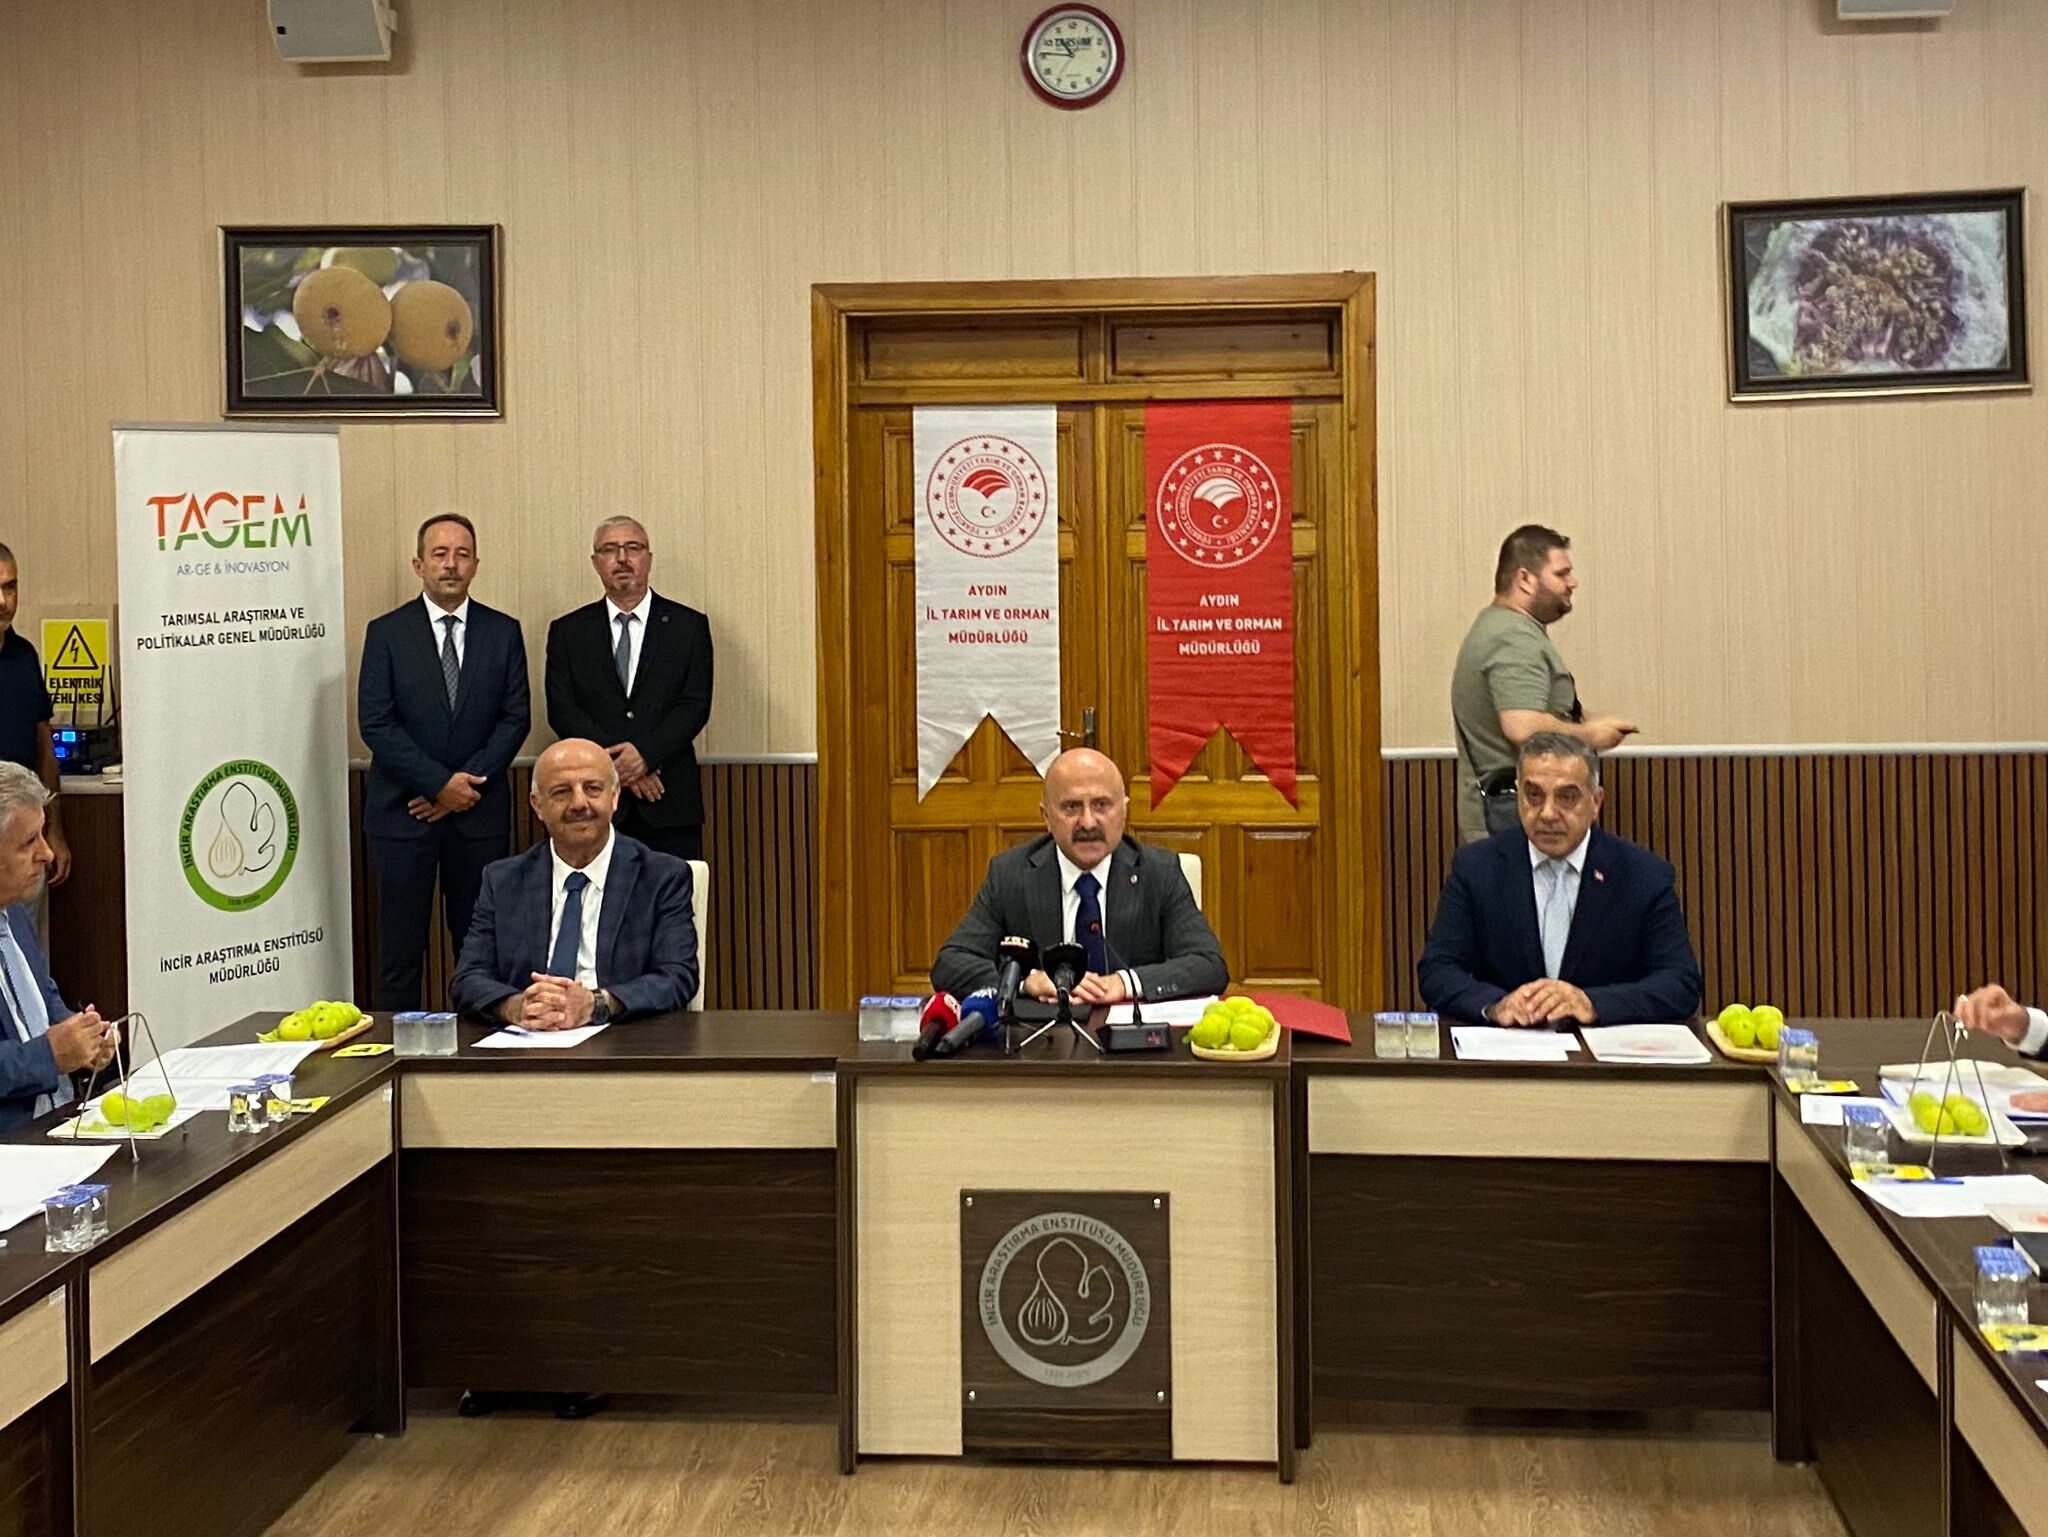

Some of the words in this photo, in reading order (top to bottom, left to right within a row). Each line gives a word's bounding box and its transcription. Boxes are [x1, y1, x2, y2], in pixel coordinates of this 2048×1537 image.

[146, 491, 312, 551] TAGEM
[176, 562, 211, 576] AR-GE
[214, 562, 222, 575] &
[225, 559, 290, 575] İNOVASYON
[968, 584, 1007, 597] AYDIN
[1199, 594, 1240, 607] AYDIN
[161, 612, 220, 627] TARIMSAL
[223, 609, 287, 625] ARAŞTIRMA
[290, 607, 305, 620] VE
[926, 605, 938, 620] İL
[941, 608, 981, 620] TARIM
[984, 608, 1001, 620] VE
[1003, 608, 1050, 620] ORMAN
[1156, 615, 1170, 631] İL
[1172, 619, 1214, 631] TARIM
[1216, 618, 1233, 631] VE
[1235, 618, 1283, 631] ORMAN
[137, 633, 215, 650] POLİTİKALAR
[218, 630, 256, 645] GENEL
[259, 623, 326, 642] MÜDÜRLÜĞÜ
[948, 629, 1028, 644] MÜDÜRLÜĞÜ
[160, 953, 193, 973] İNCİR
[195, 942, 262, 965] ARAŞTIRMA
[264, 927, 324, 953] ENSTİTÜSÜ
[209, 957, 280, 985] MÜDÜRLÜĞÜ
